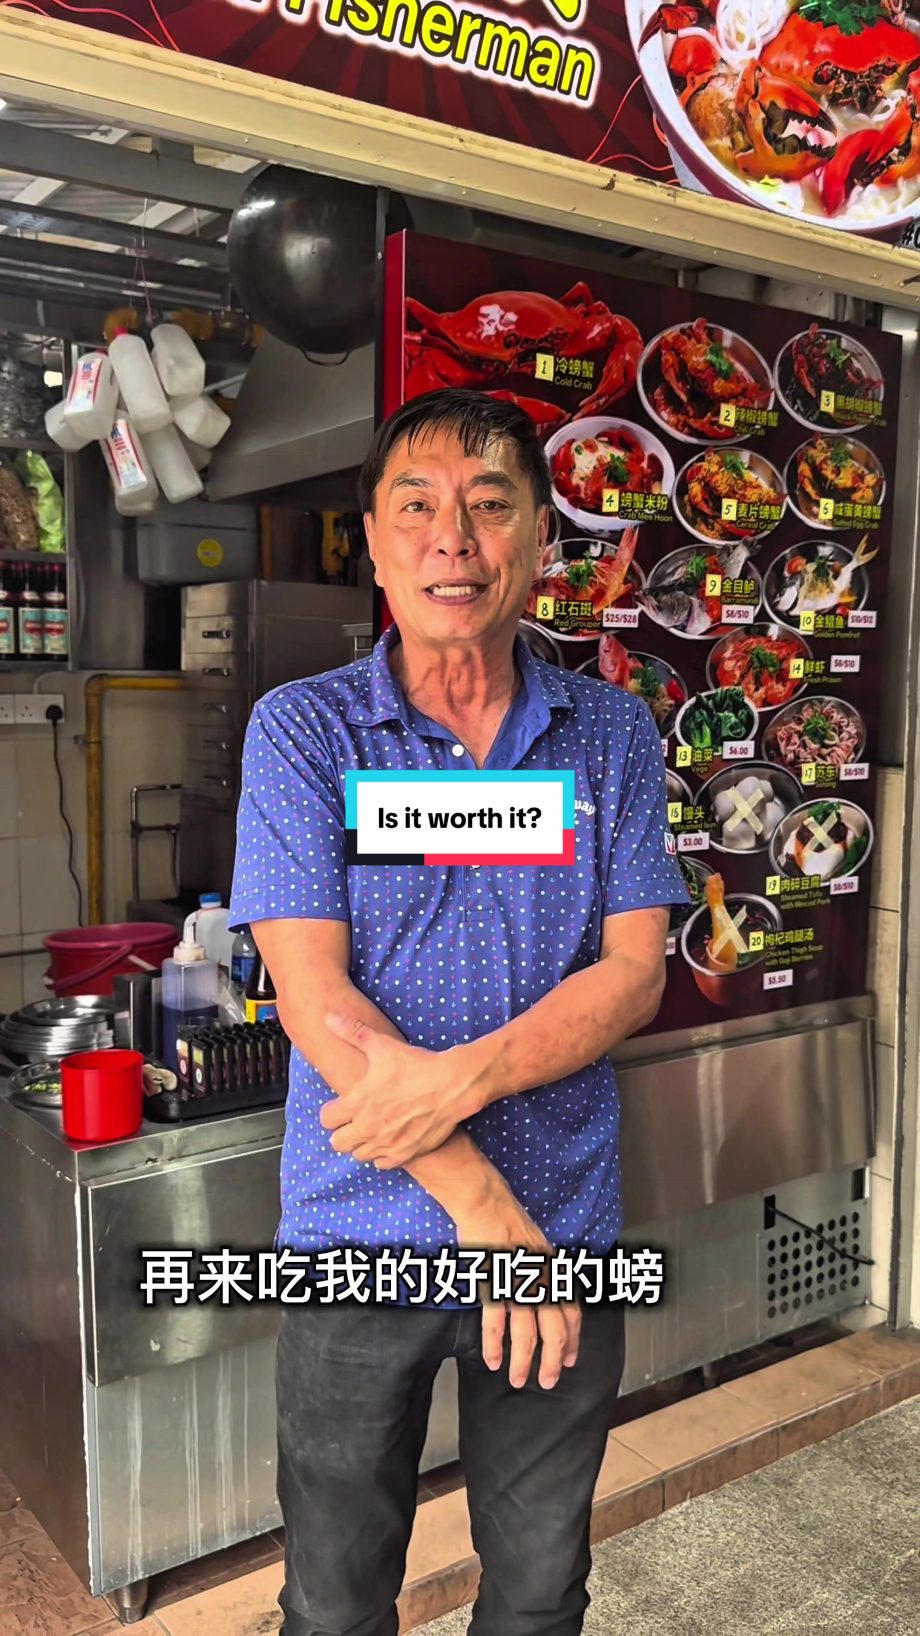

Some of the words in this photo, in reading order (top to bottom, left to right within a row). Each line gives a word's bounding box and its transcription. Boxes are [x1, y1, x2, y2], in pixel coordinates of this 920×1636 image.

[555, 356, 595, 378] 冷螃蟹
[554, 375, 573, 387] Cold
[573, 378, 593, 391] Crab
[735, 406, 779, 428] 辣椒螃蟹
[620, 491, 669, 512] 螃蟹米粉
[618, 509, 637, 520] Crab
[654, 513, 673, 523] Hoon
[737, 502, 781, 520] 麦片螃蟹
[722, 577, 755, 594] 金目鲈
[554, 599, 593, 617] 红石斑
[726, 608, 750, 619] $8/$10
[554, 618, 570, 628] Red
[570, 618, 601, 629] Grouper
[605, 612, 637, 624] $25/$28
[815, 614, 845, 629] 金鲳鱼
[804, 659, 825, 674] 鲜虾
[692, 747, 714, 763] 油菜
[728, 746, 750, 756] $6.00
[691, 764, 709, 775] Vege
[683, 805, 706, 821] 馒头
[682, 836, 703, 847] $3.00
[751, 936, 762, 947] 20
[768, 974, 787, 985] $5.50
